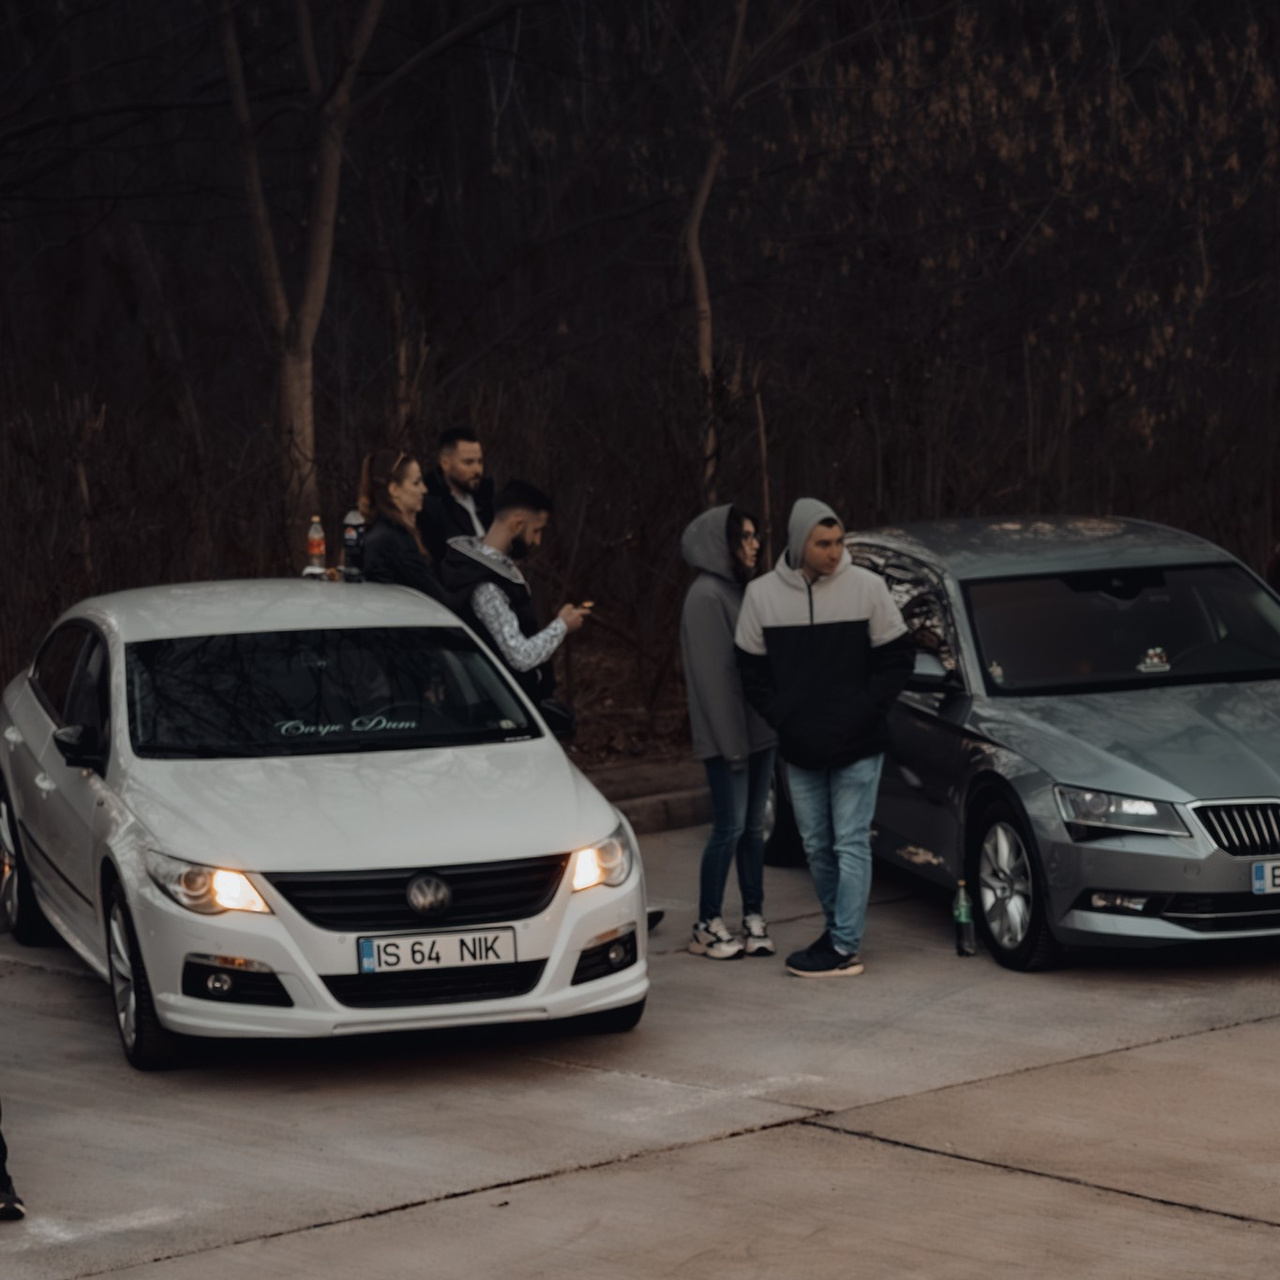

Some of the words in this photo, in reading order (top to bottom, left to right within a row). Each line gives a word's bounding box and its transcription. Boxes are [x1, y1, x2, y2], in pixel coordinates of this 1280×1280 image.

[376, 942, 401, 968] IS
[411, 940, 440, 965] 64
[459, 935, 501, 962] NIK
